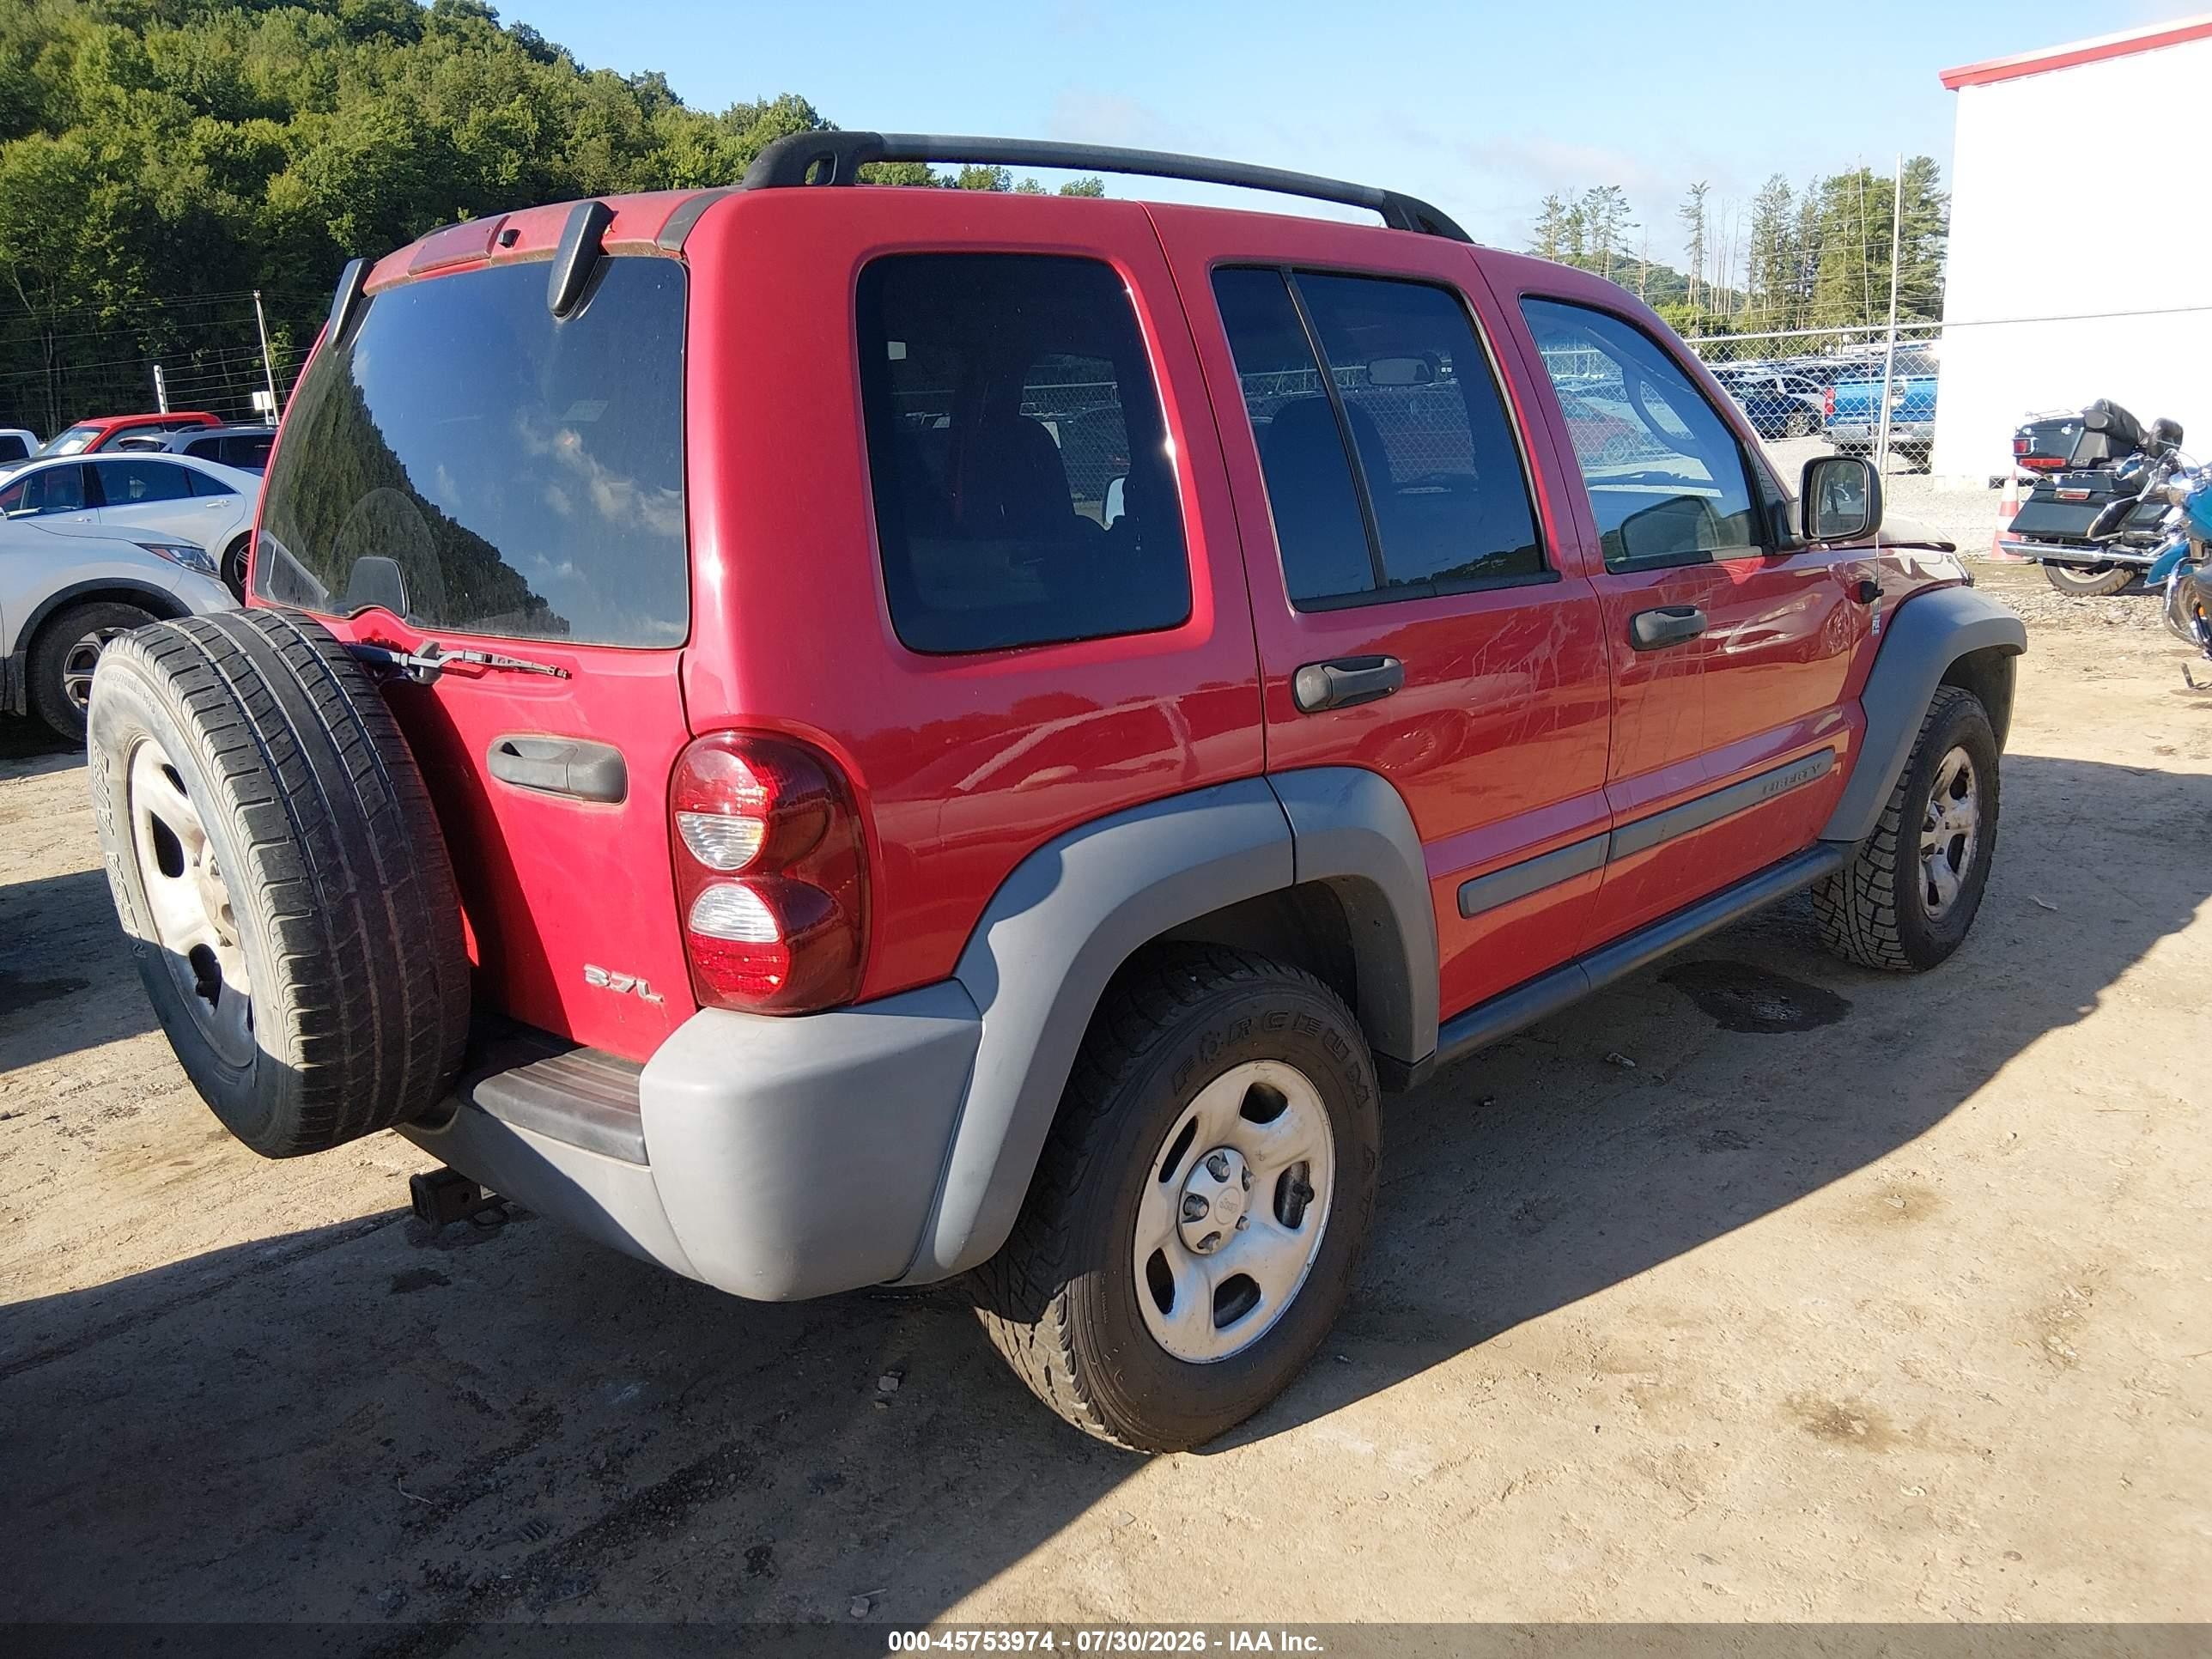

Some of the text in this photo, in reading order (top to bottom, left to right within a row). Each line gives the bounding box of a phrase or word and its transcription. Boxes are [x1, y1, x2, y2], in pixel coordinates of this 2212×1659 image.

[1763, 762, 1821, 795] LIBERTY
[106, 851, 147, 959] MESA
[1172, 1010, 1370, 1109] FORCEUM
[1218, 1196, 1239, 1214] Jeep
